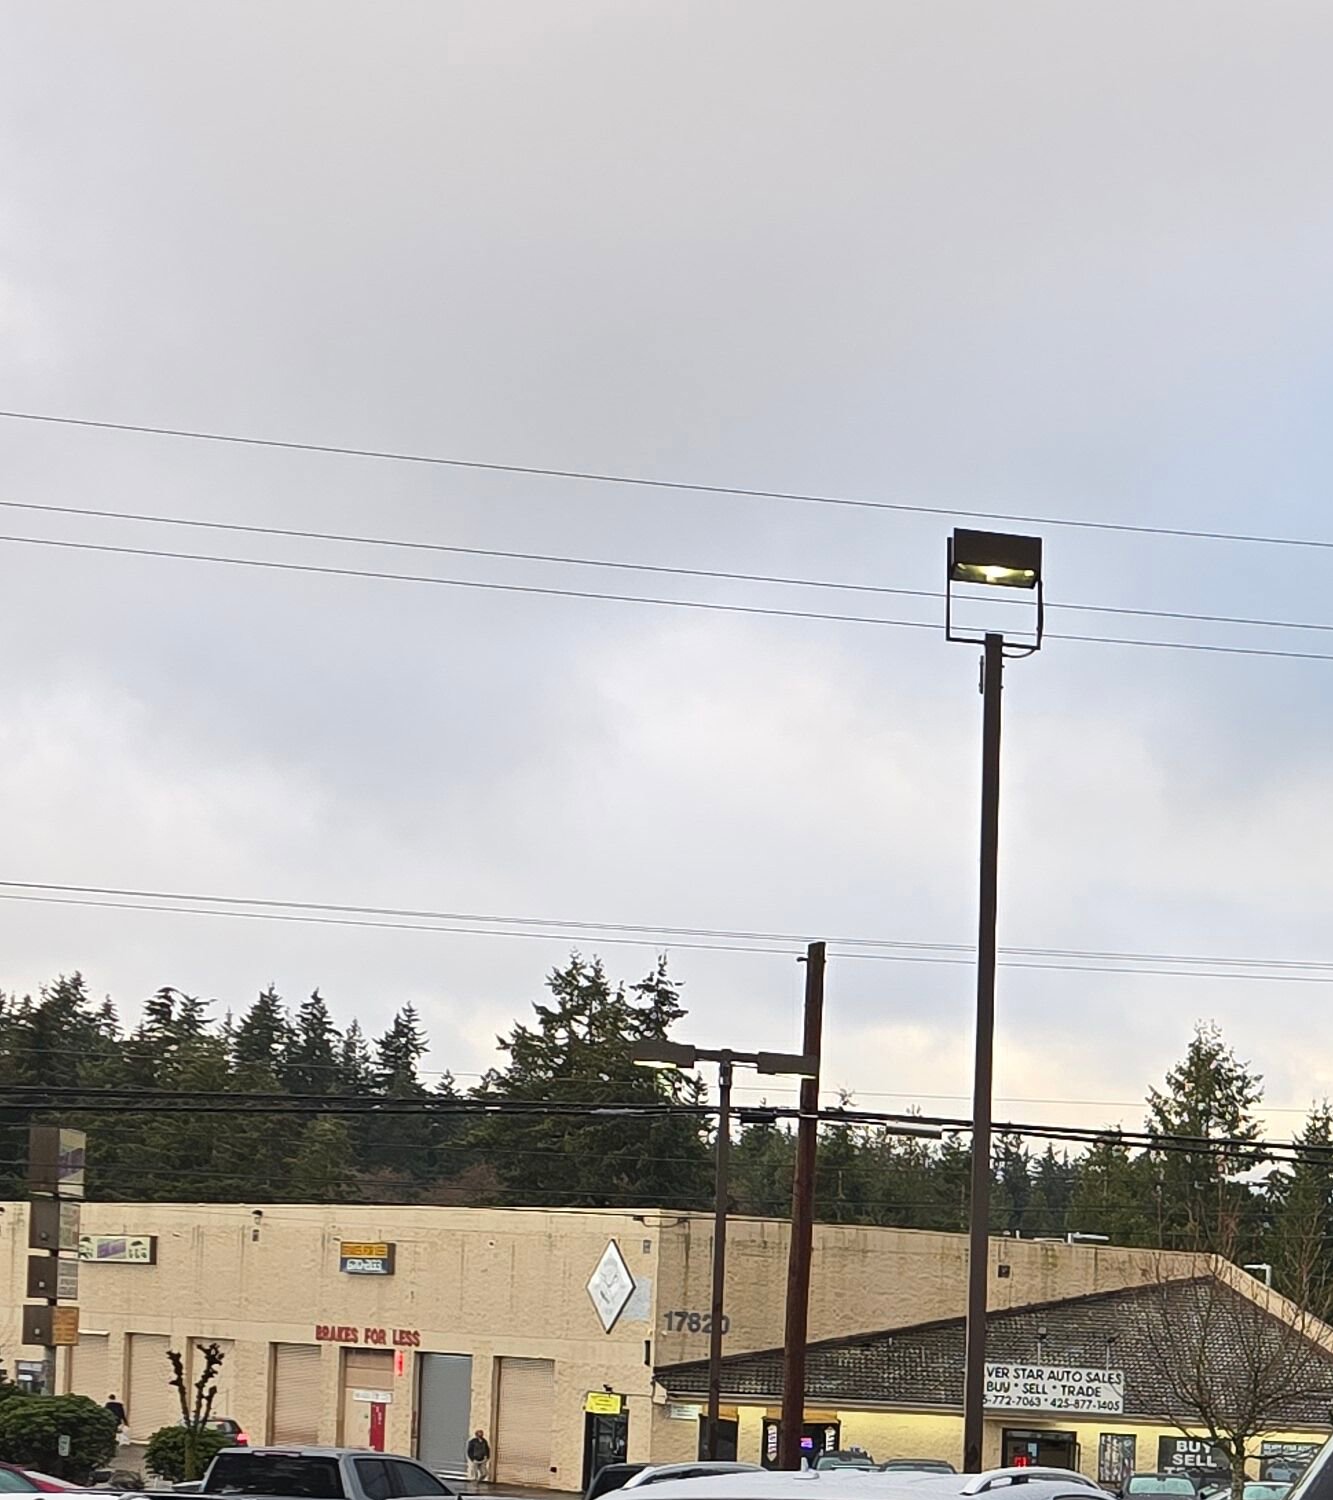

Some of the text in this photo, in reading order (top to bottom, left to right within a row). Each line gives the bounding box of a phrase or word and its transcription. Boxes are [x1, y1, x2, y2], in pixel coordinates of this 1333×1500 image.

[663, 1311, 731, 1335] 17820
[315, 1325, 421, 1347] BRAKES FOR LESS
[1013, 1367, 1044, 1381] STAR
[1047, 1370, 1083, 1382] AUTO
[1085, 1371, 1122, 1384] SALES
[986, 1381, 1102, 1397] BUY SELL TRADE
[1176, 1440, 1215, 1454] BUY
[1172, 1453, 1218, 1468] SELL
